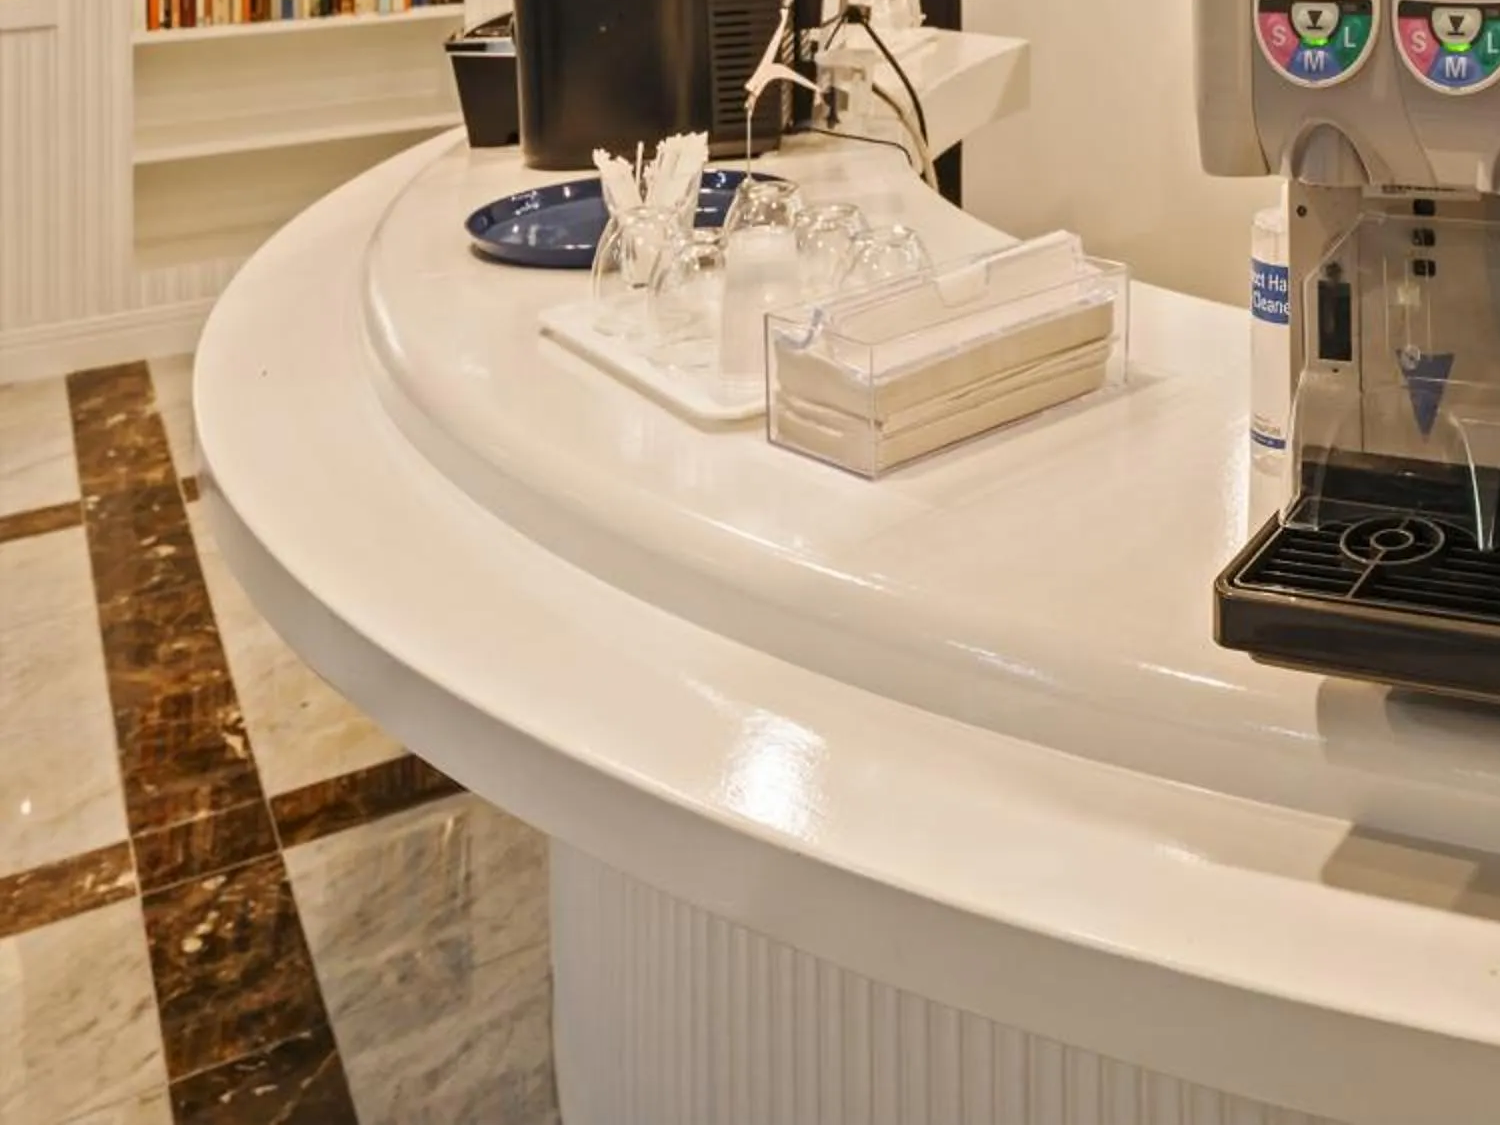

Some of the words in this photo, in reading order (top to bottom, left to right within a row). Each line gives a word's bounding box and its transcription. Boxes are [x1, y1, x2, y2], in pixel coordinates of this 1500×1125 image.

[1271, 24, 1287, 46] S
[1343, 26, 1357, 48] L
[1411, 30, 1427, 52] S
[1486, 32, 1499, 54] L
[1303, 50, 1325, 72] M
[1445, 56, 1467, 78] M
